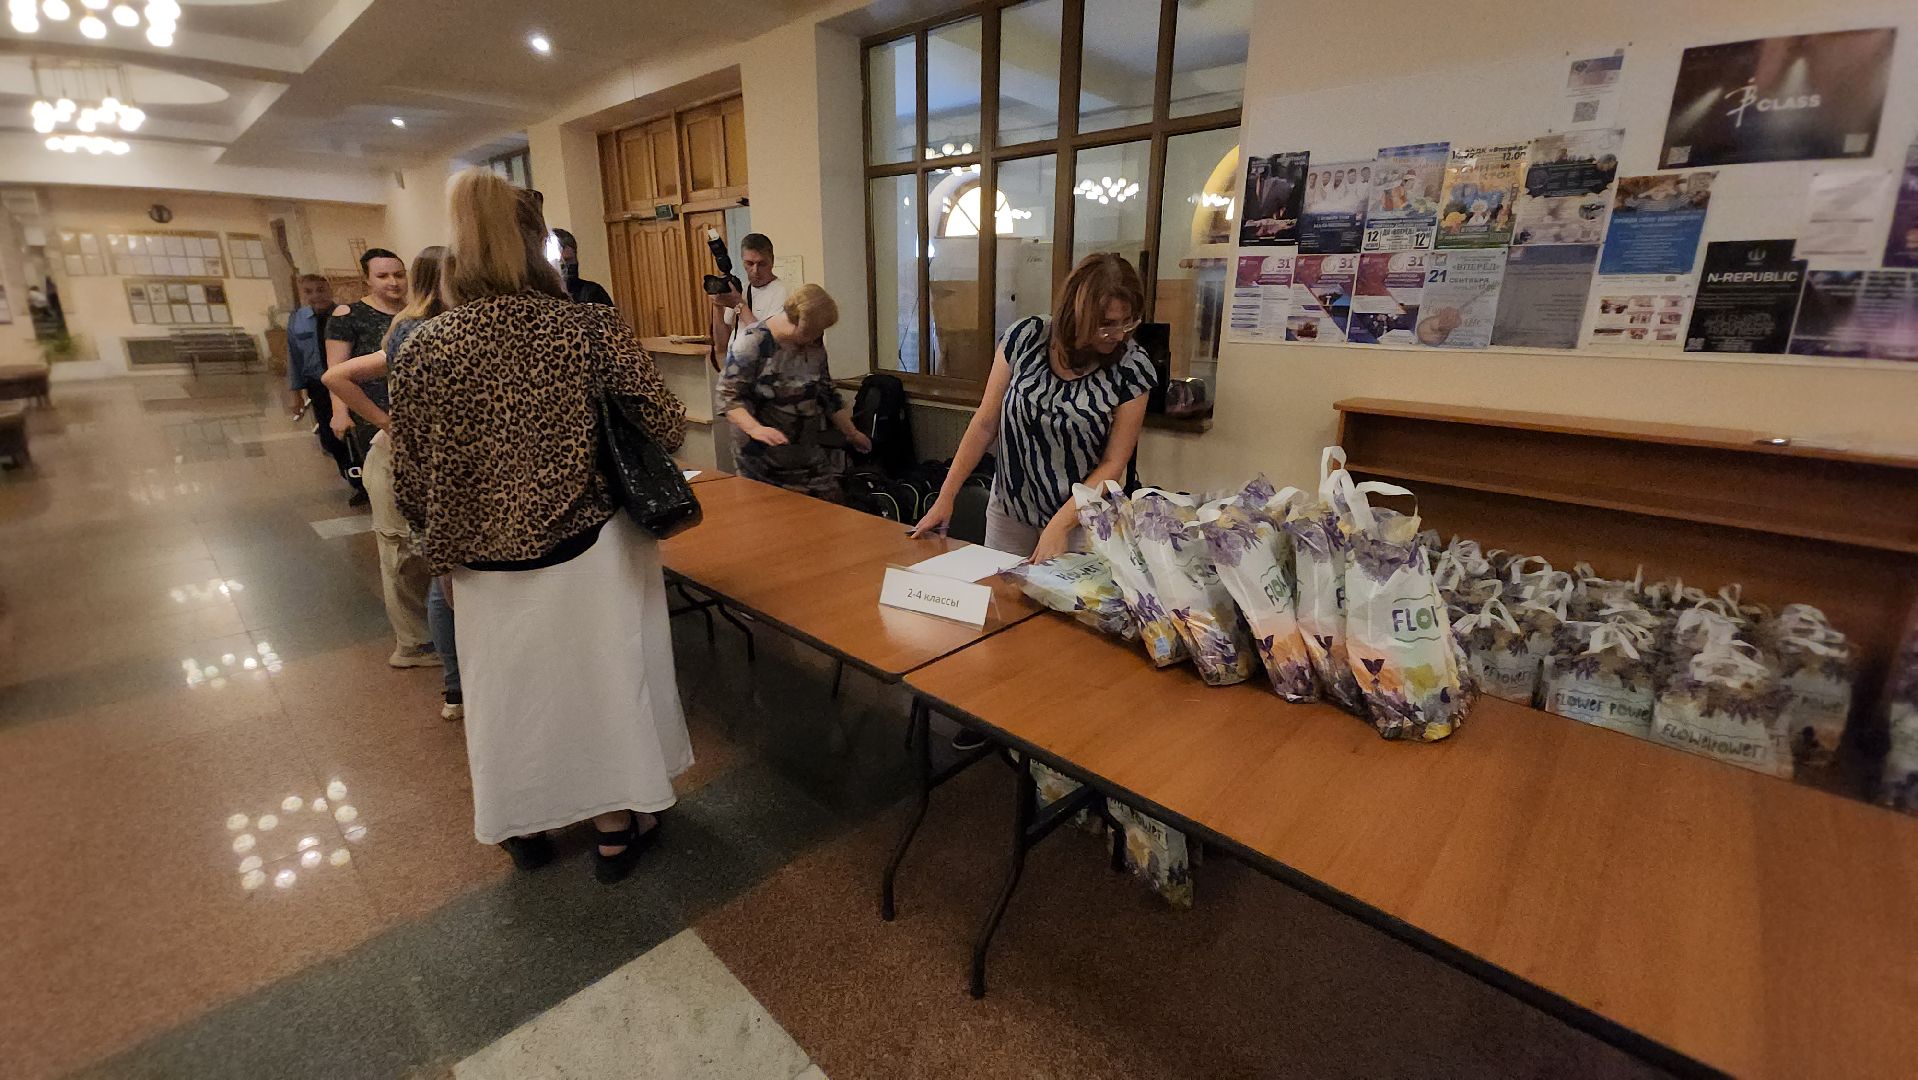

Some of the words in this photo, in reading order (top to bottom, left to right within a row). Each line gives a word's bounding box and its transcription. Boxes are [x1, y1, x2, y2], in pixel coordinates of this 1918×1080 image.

[1756, 95, 1821, 112] CLASS
[1367, 230, 1379, 242] 12
[1277, 258, 1291, 269] 31
[1339, 257, 1353, 269] 31
[1408, 256, 1424, 267] 31
[1428, 269, 1447, 283] 21
[1706, 271, 1799, 283] N-REPUBLIC
[907, 587, 922, 600] 2-4
[924, 592, 960, 608] классы
